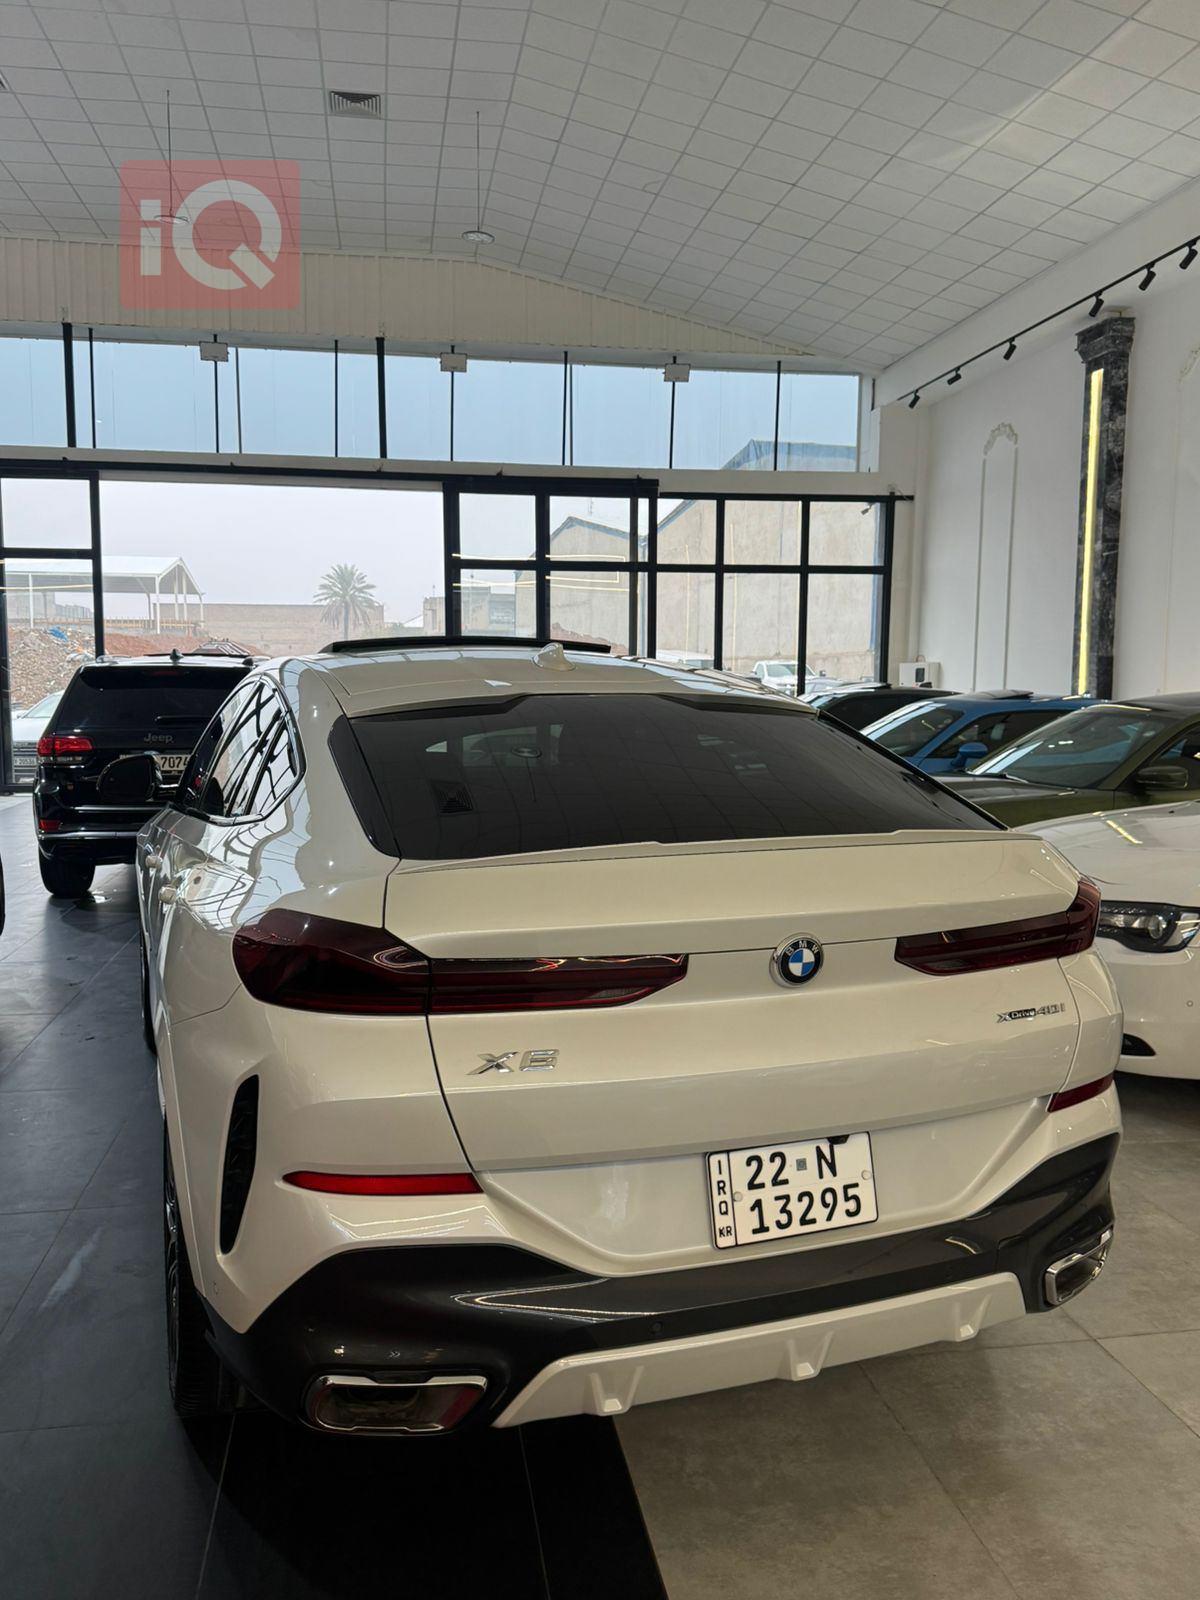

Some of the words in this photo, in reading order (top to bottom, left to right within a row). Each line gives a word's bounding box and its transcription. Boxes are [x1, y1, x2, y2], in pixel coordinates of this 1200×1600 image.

[143, 733, 173, 744] Jeep
[785, 940, 819, 956] BMW
[464, 1049, 560, 1075] X6
[745, 1151, 790, 1191] 22
[815, 1144, 838, 1180] N
[717, 1159, 729, 1216] IRQ
[750, 1182, 862, 1235] 13295
[718, 1225, 733, 1238] KR
